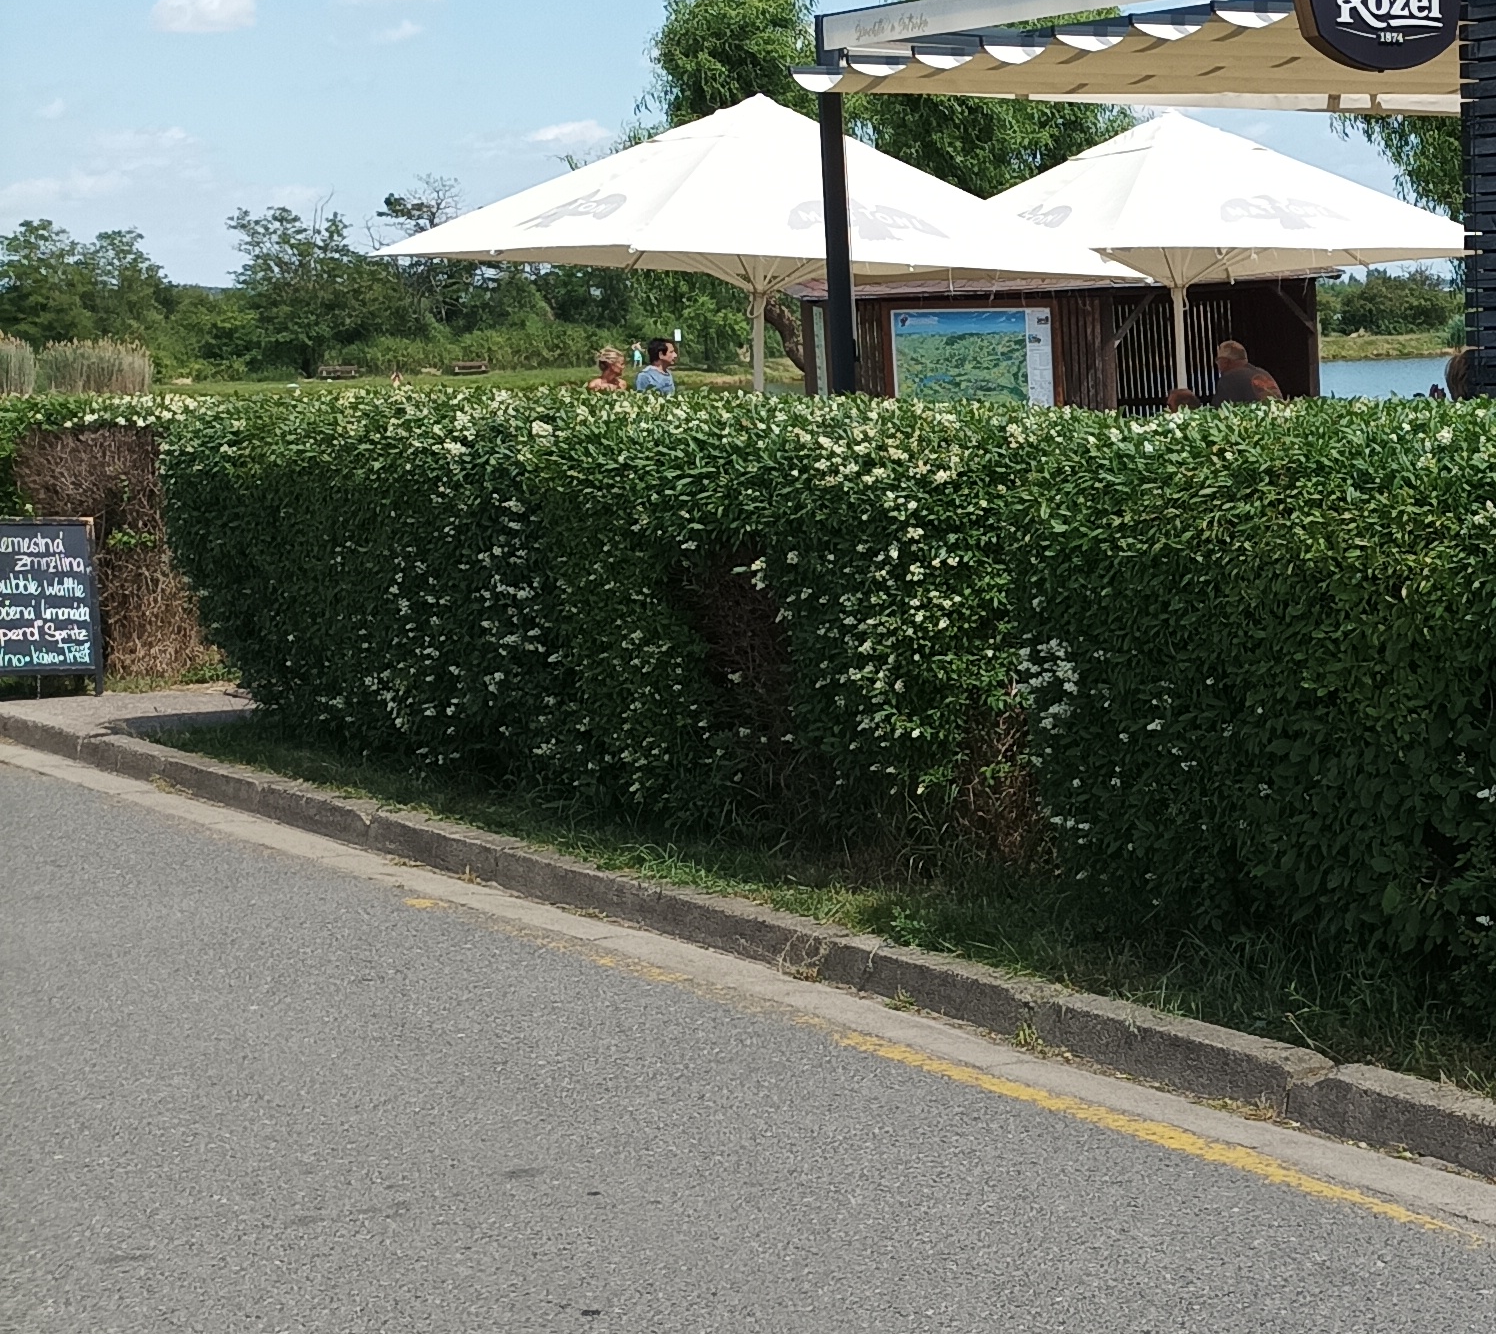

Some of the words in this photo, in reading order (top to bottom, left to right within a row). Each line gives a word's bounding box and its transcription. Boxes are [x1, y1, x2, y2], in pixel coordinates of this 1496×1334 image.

[1378, 31, 1404, 44] 1874
[798, 204, 924, 231] MTONI
[0, 531, 65, 553] emeslná
[0, 573, 41, 595] ubble
[0, 598, 35, 621] očená
[0, 620, 40, 646] perol
[44, 622, 89, 646] Spritz
